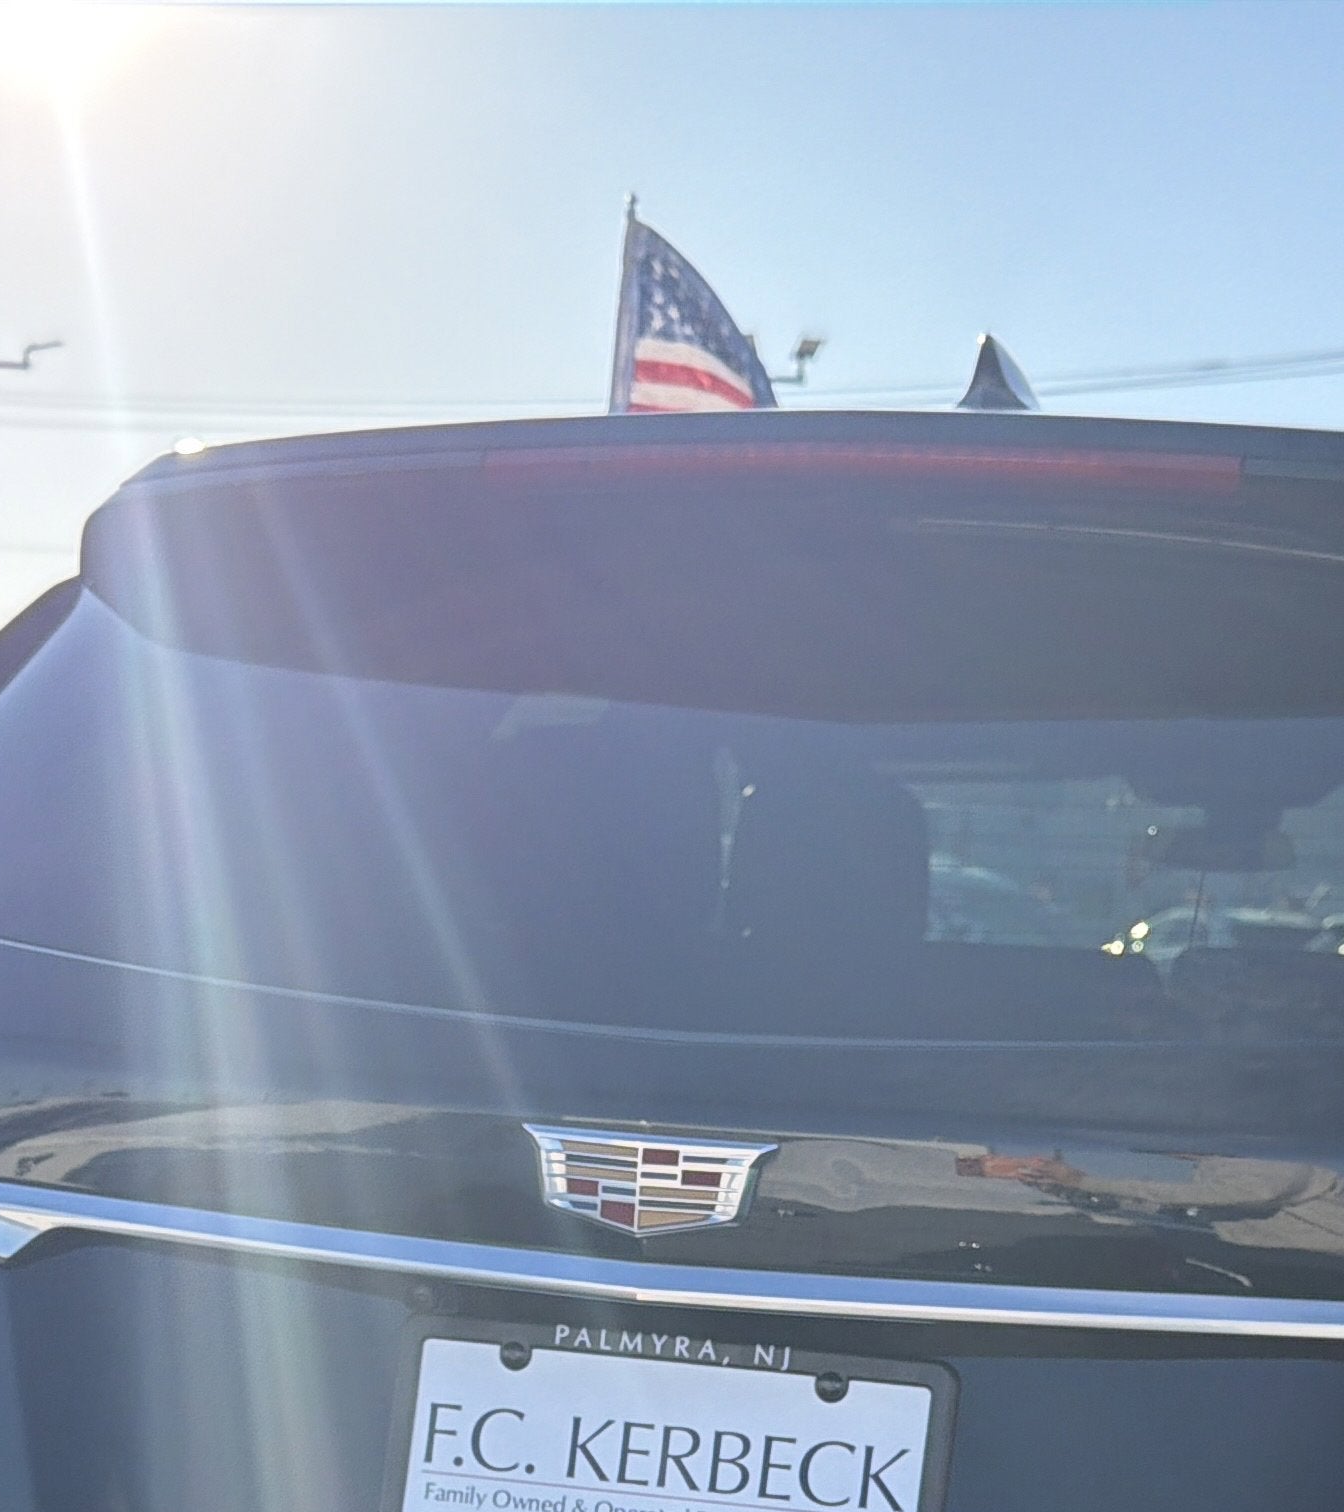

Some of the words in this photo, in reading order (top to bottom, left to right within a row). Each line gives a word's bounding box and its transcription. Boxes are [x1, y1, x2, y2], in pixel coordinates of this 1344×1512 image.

[554, 1324, 730, 1366] PALMYRA,
[752, 1344, 792, 1371] NJ
[422, 1402, 536, 1476] F.C.
[565, 1416, 912, 1512] KERBECK
[423, 1481, 488, 1511] Family
